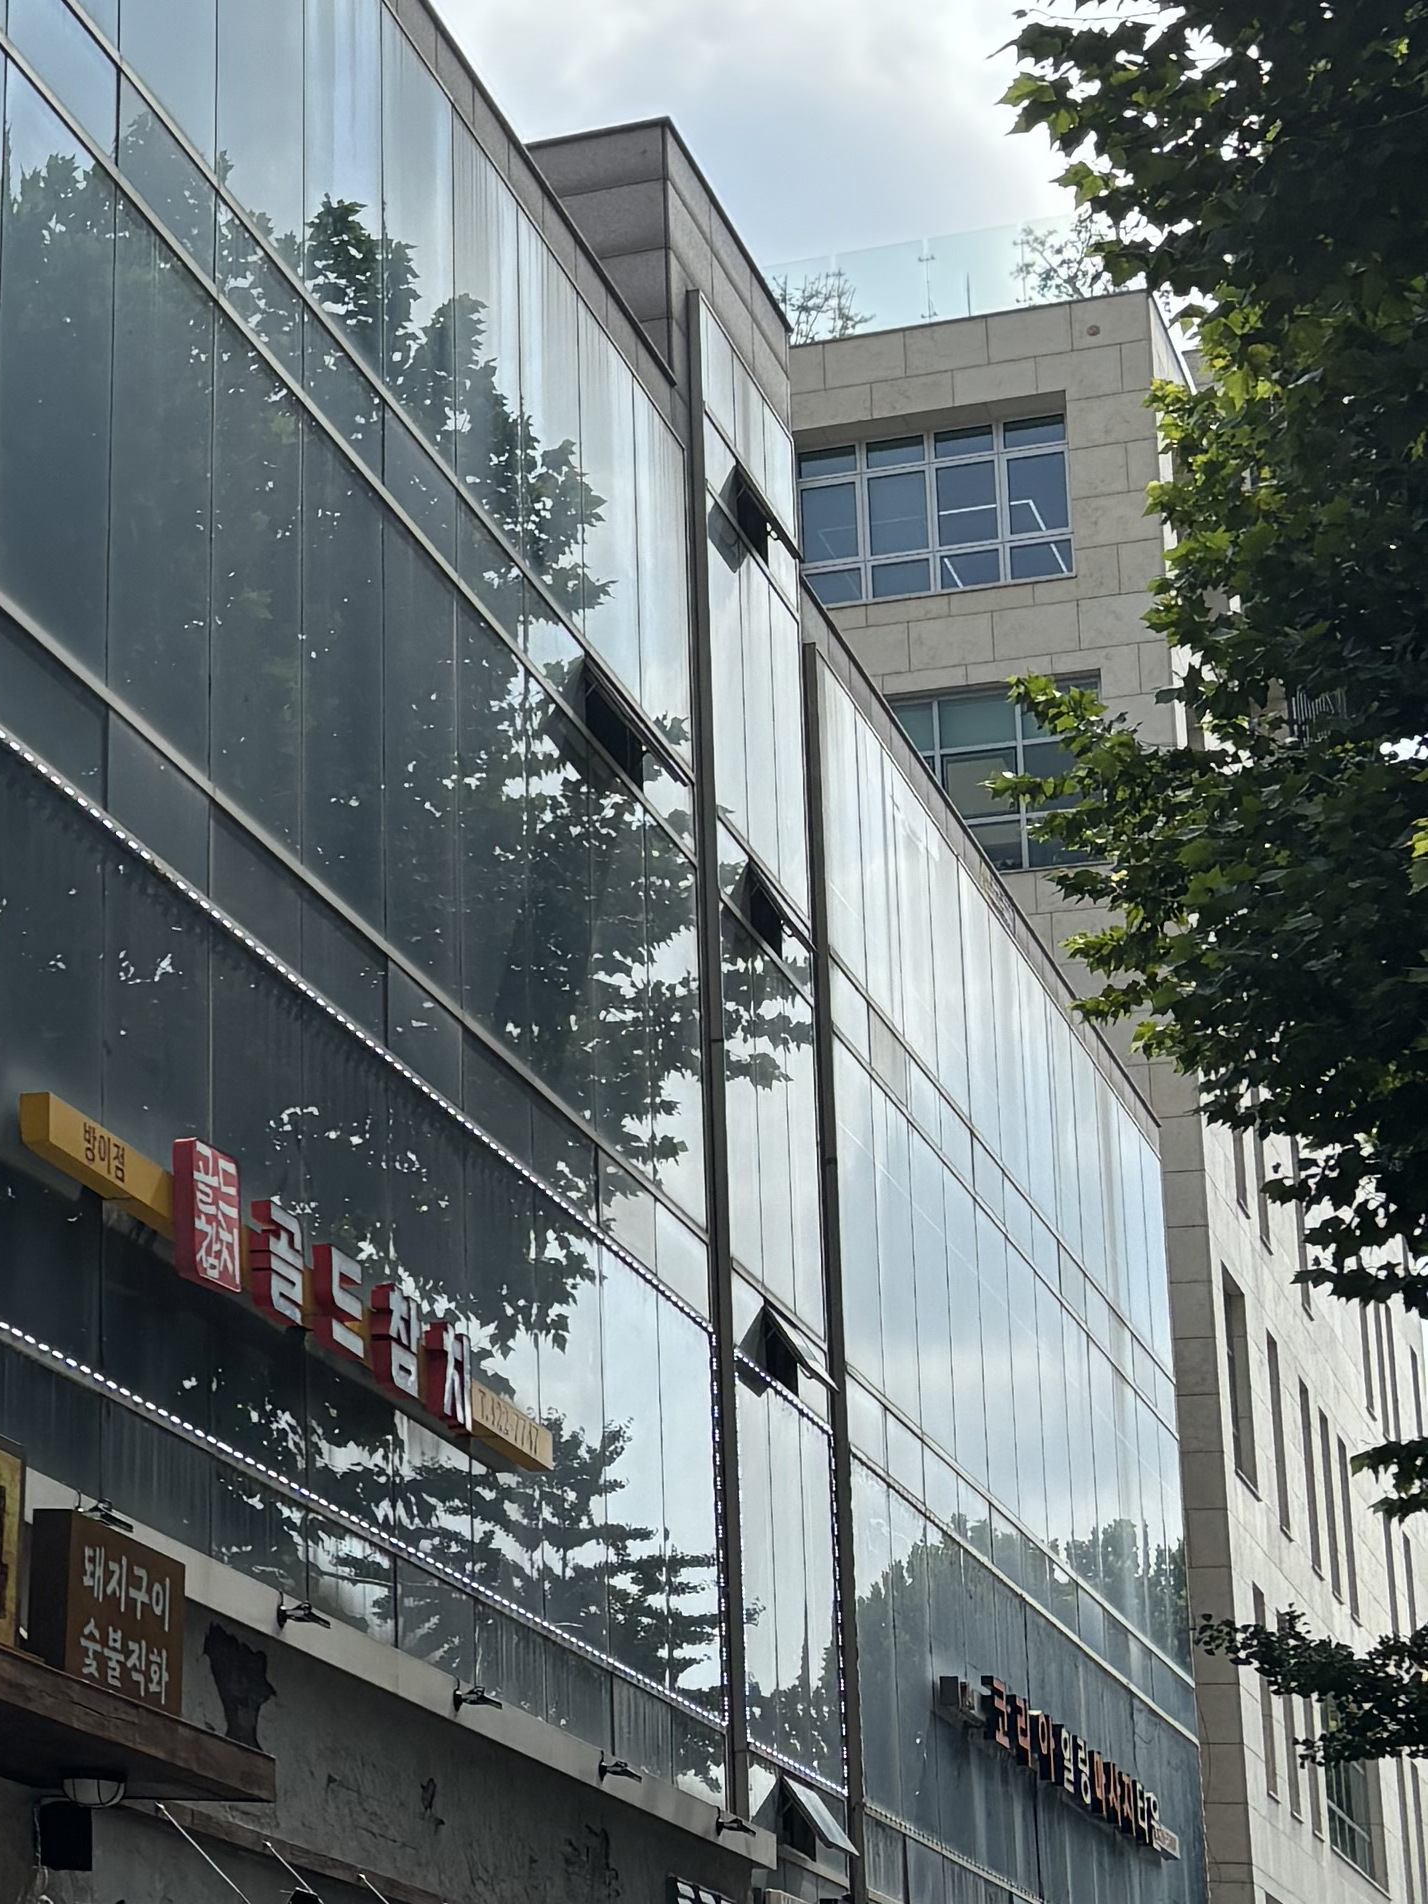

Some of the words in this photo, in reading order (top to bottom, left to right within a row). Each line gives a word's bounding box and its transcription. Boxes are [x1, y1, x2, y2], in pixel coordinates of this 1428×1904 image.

[83, 1122, 127, 1184] 방이점
[254, 1198, 473, 1432] 골드참치
[82, 1545, 172, 1632] 돼지구이
[79, 1625, 171, 1705] 숯불직화
